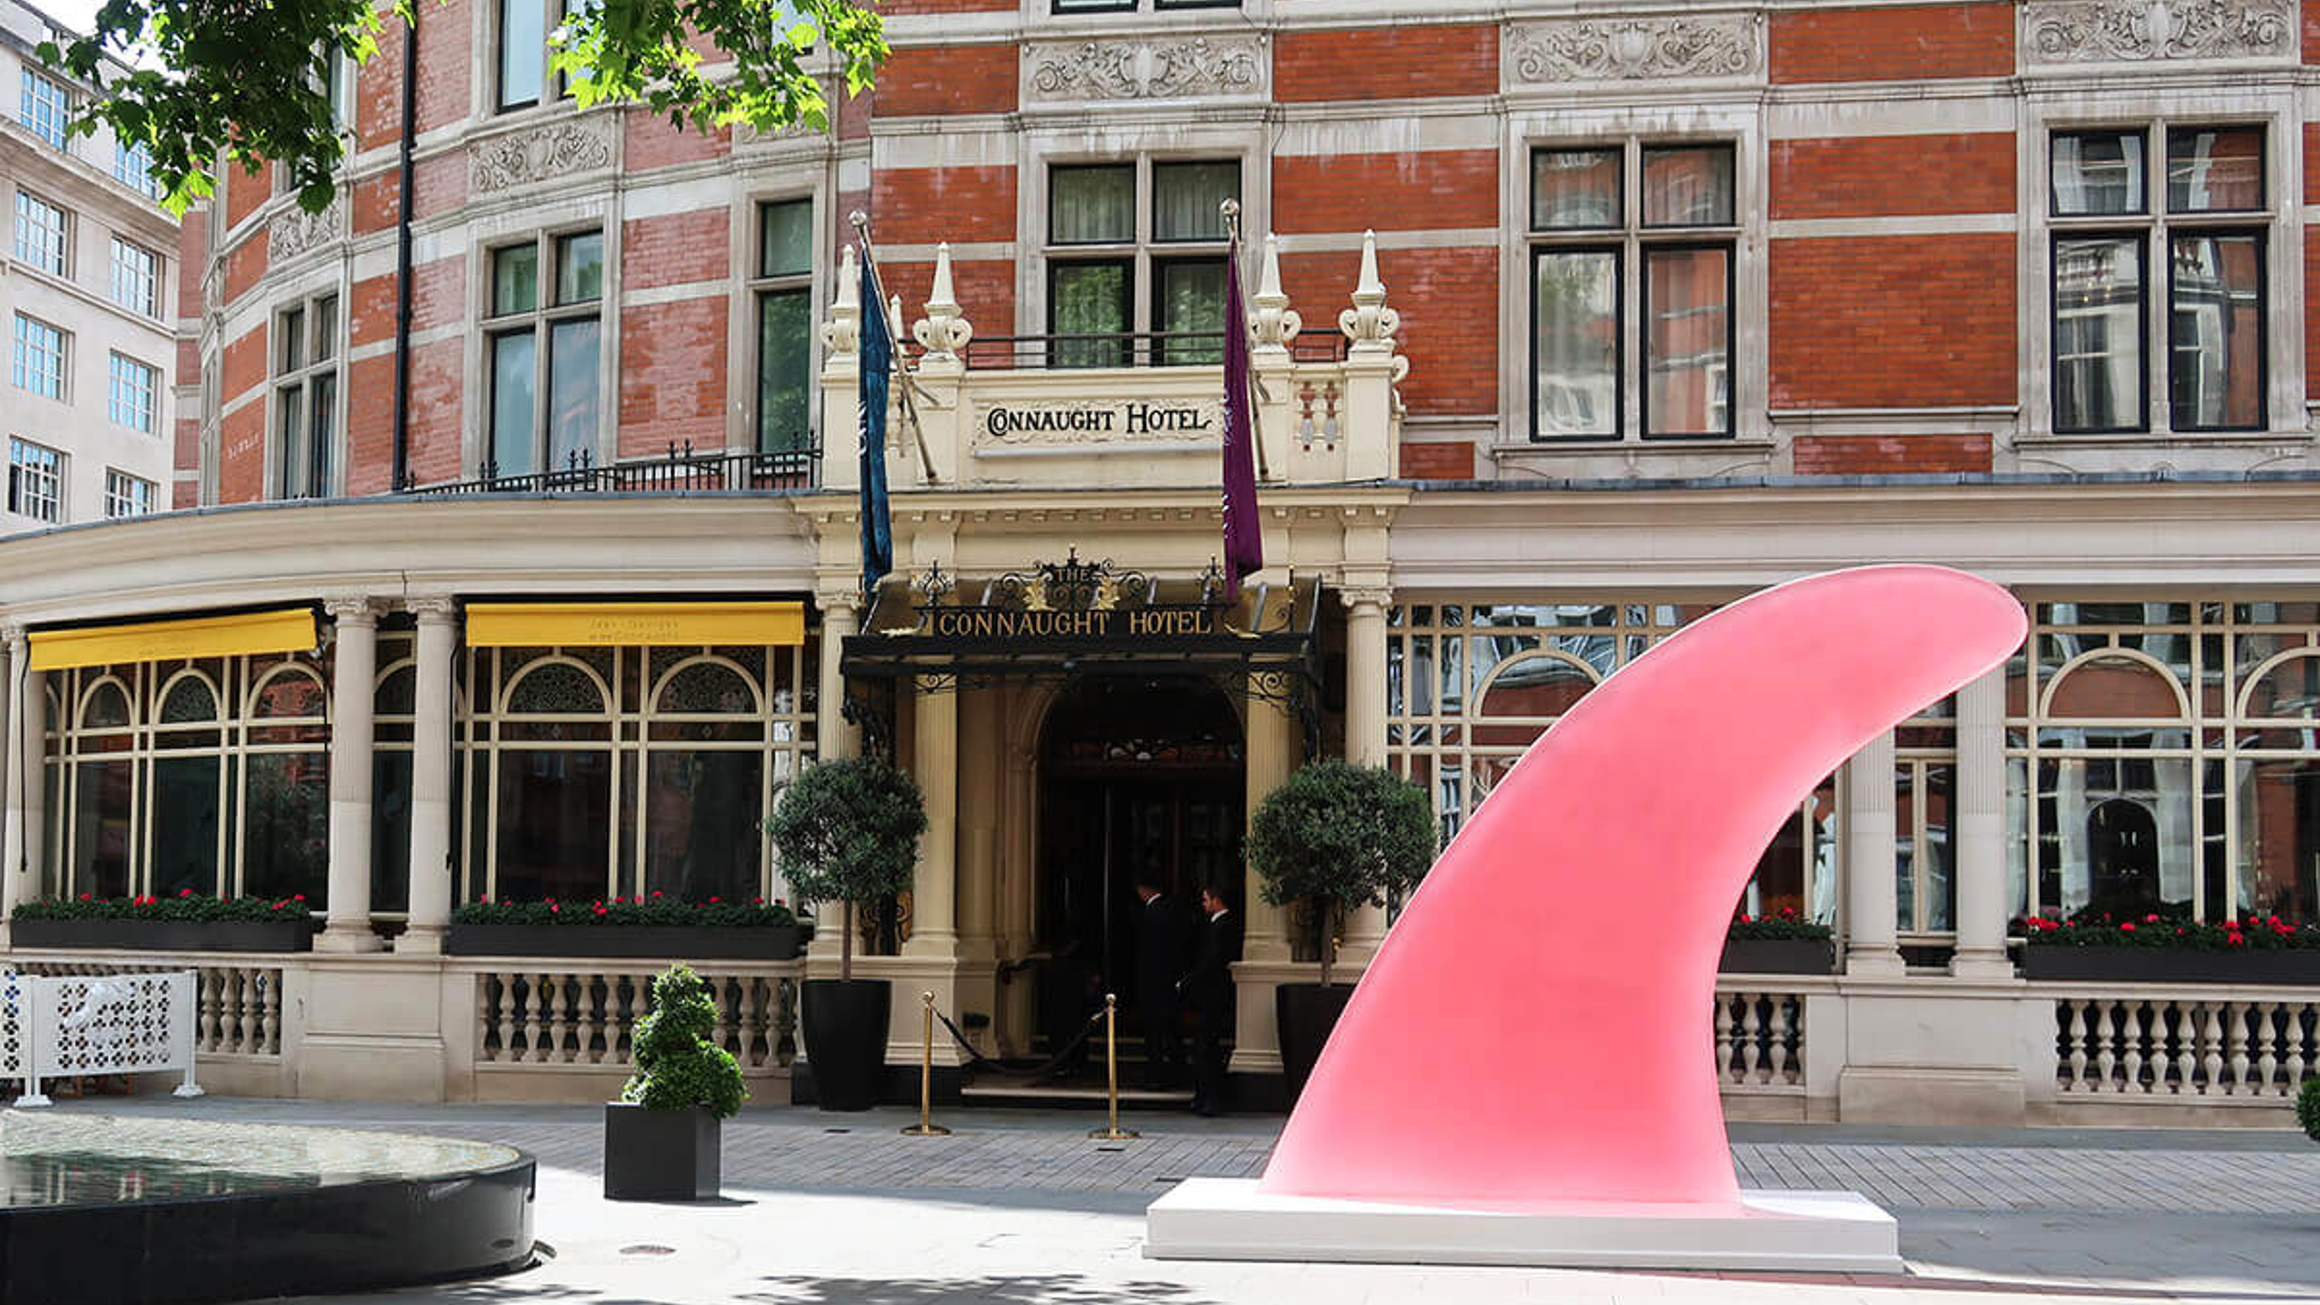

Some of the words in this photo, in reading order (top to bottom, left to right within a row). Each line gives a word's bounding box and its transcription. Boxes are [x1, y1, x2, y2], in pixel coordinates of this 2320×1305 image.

[987, 408, 1115, 436] CONNAUGHT
[1125, 404, 1213, 434] HOTEL
[1056, 569, 1089, 582] THE
[939, 611, 1110, 636] CONNAUGHT
[1130, 611, 1212, 635] HOTEL
